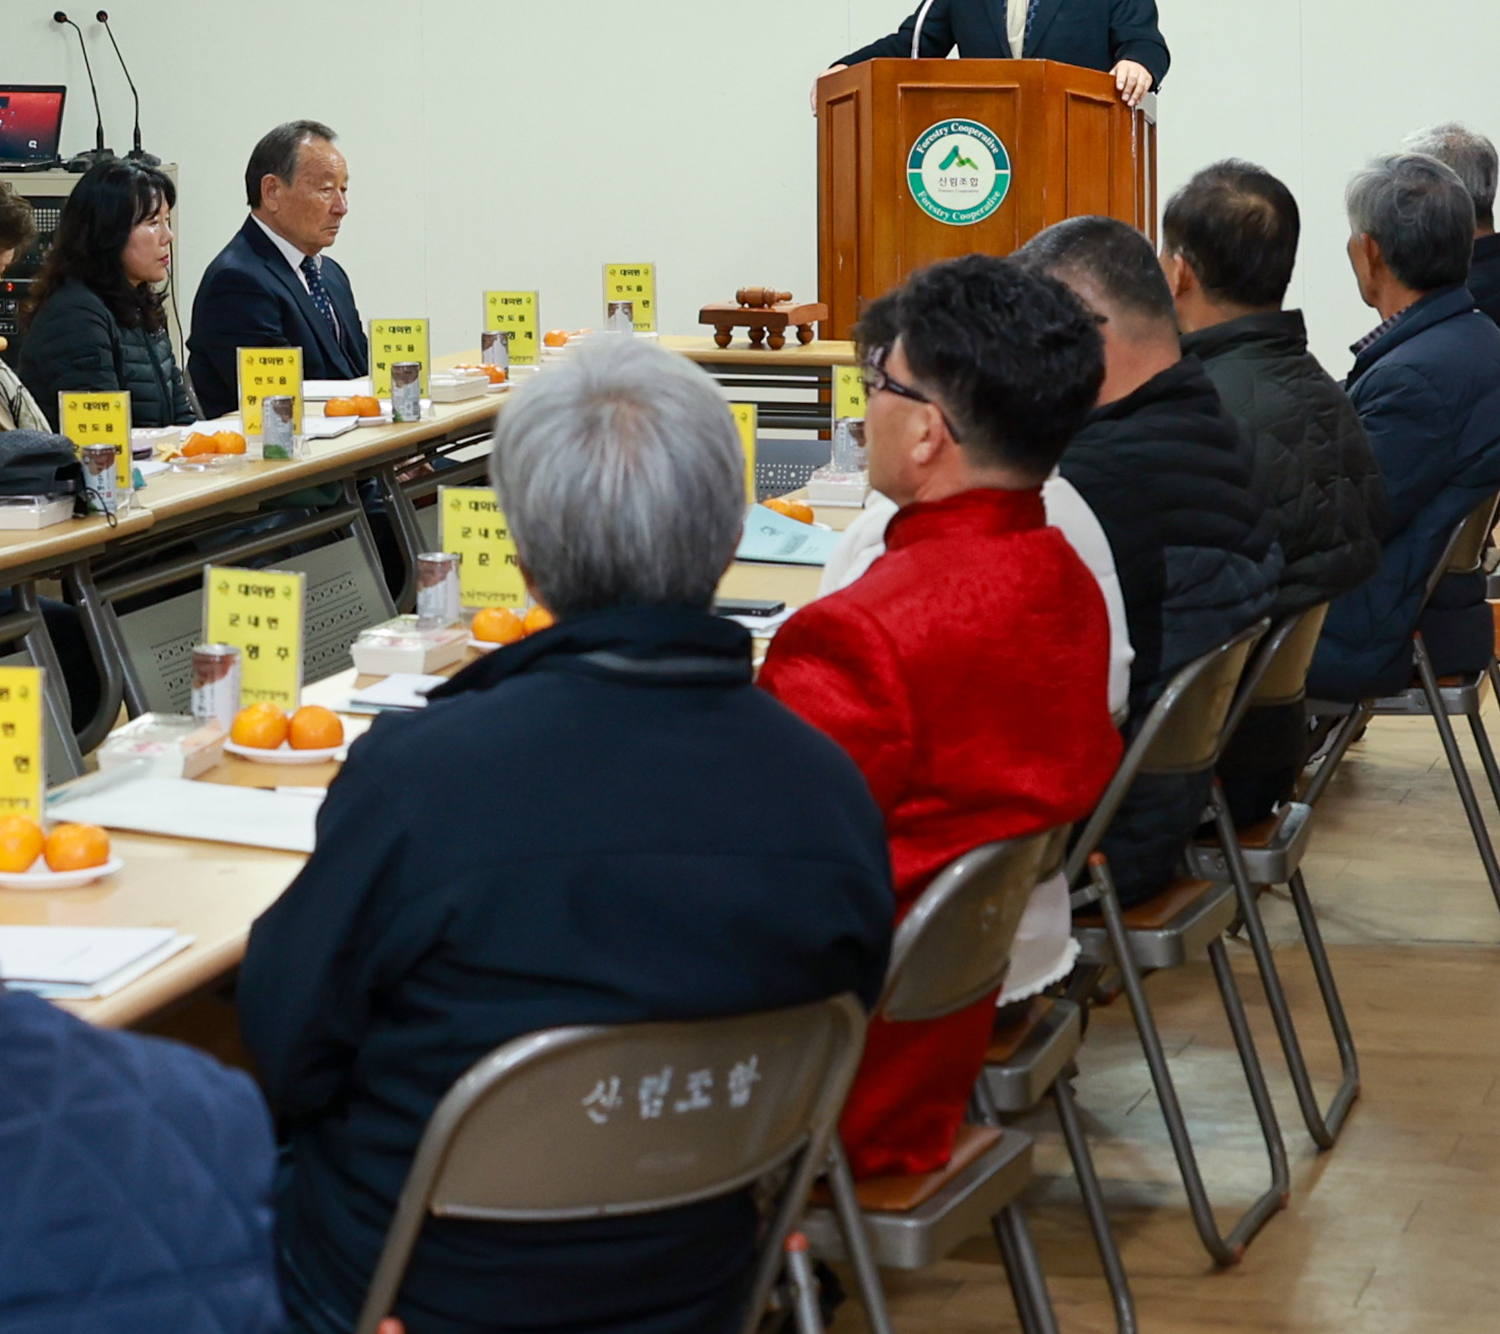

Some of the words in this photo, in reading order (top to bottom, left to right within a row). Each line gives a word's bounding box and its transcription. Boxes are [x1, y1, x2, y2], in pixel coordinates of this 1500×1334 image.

[916, 125, 949, 154] Forestry
[950, 122, 999, 155] Cooperative
[917, 190, 950, 220] Forestry
[951, 190, 1001, 221] Cooperative
